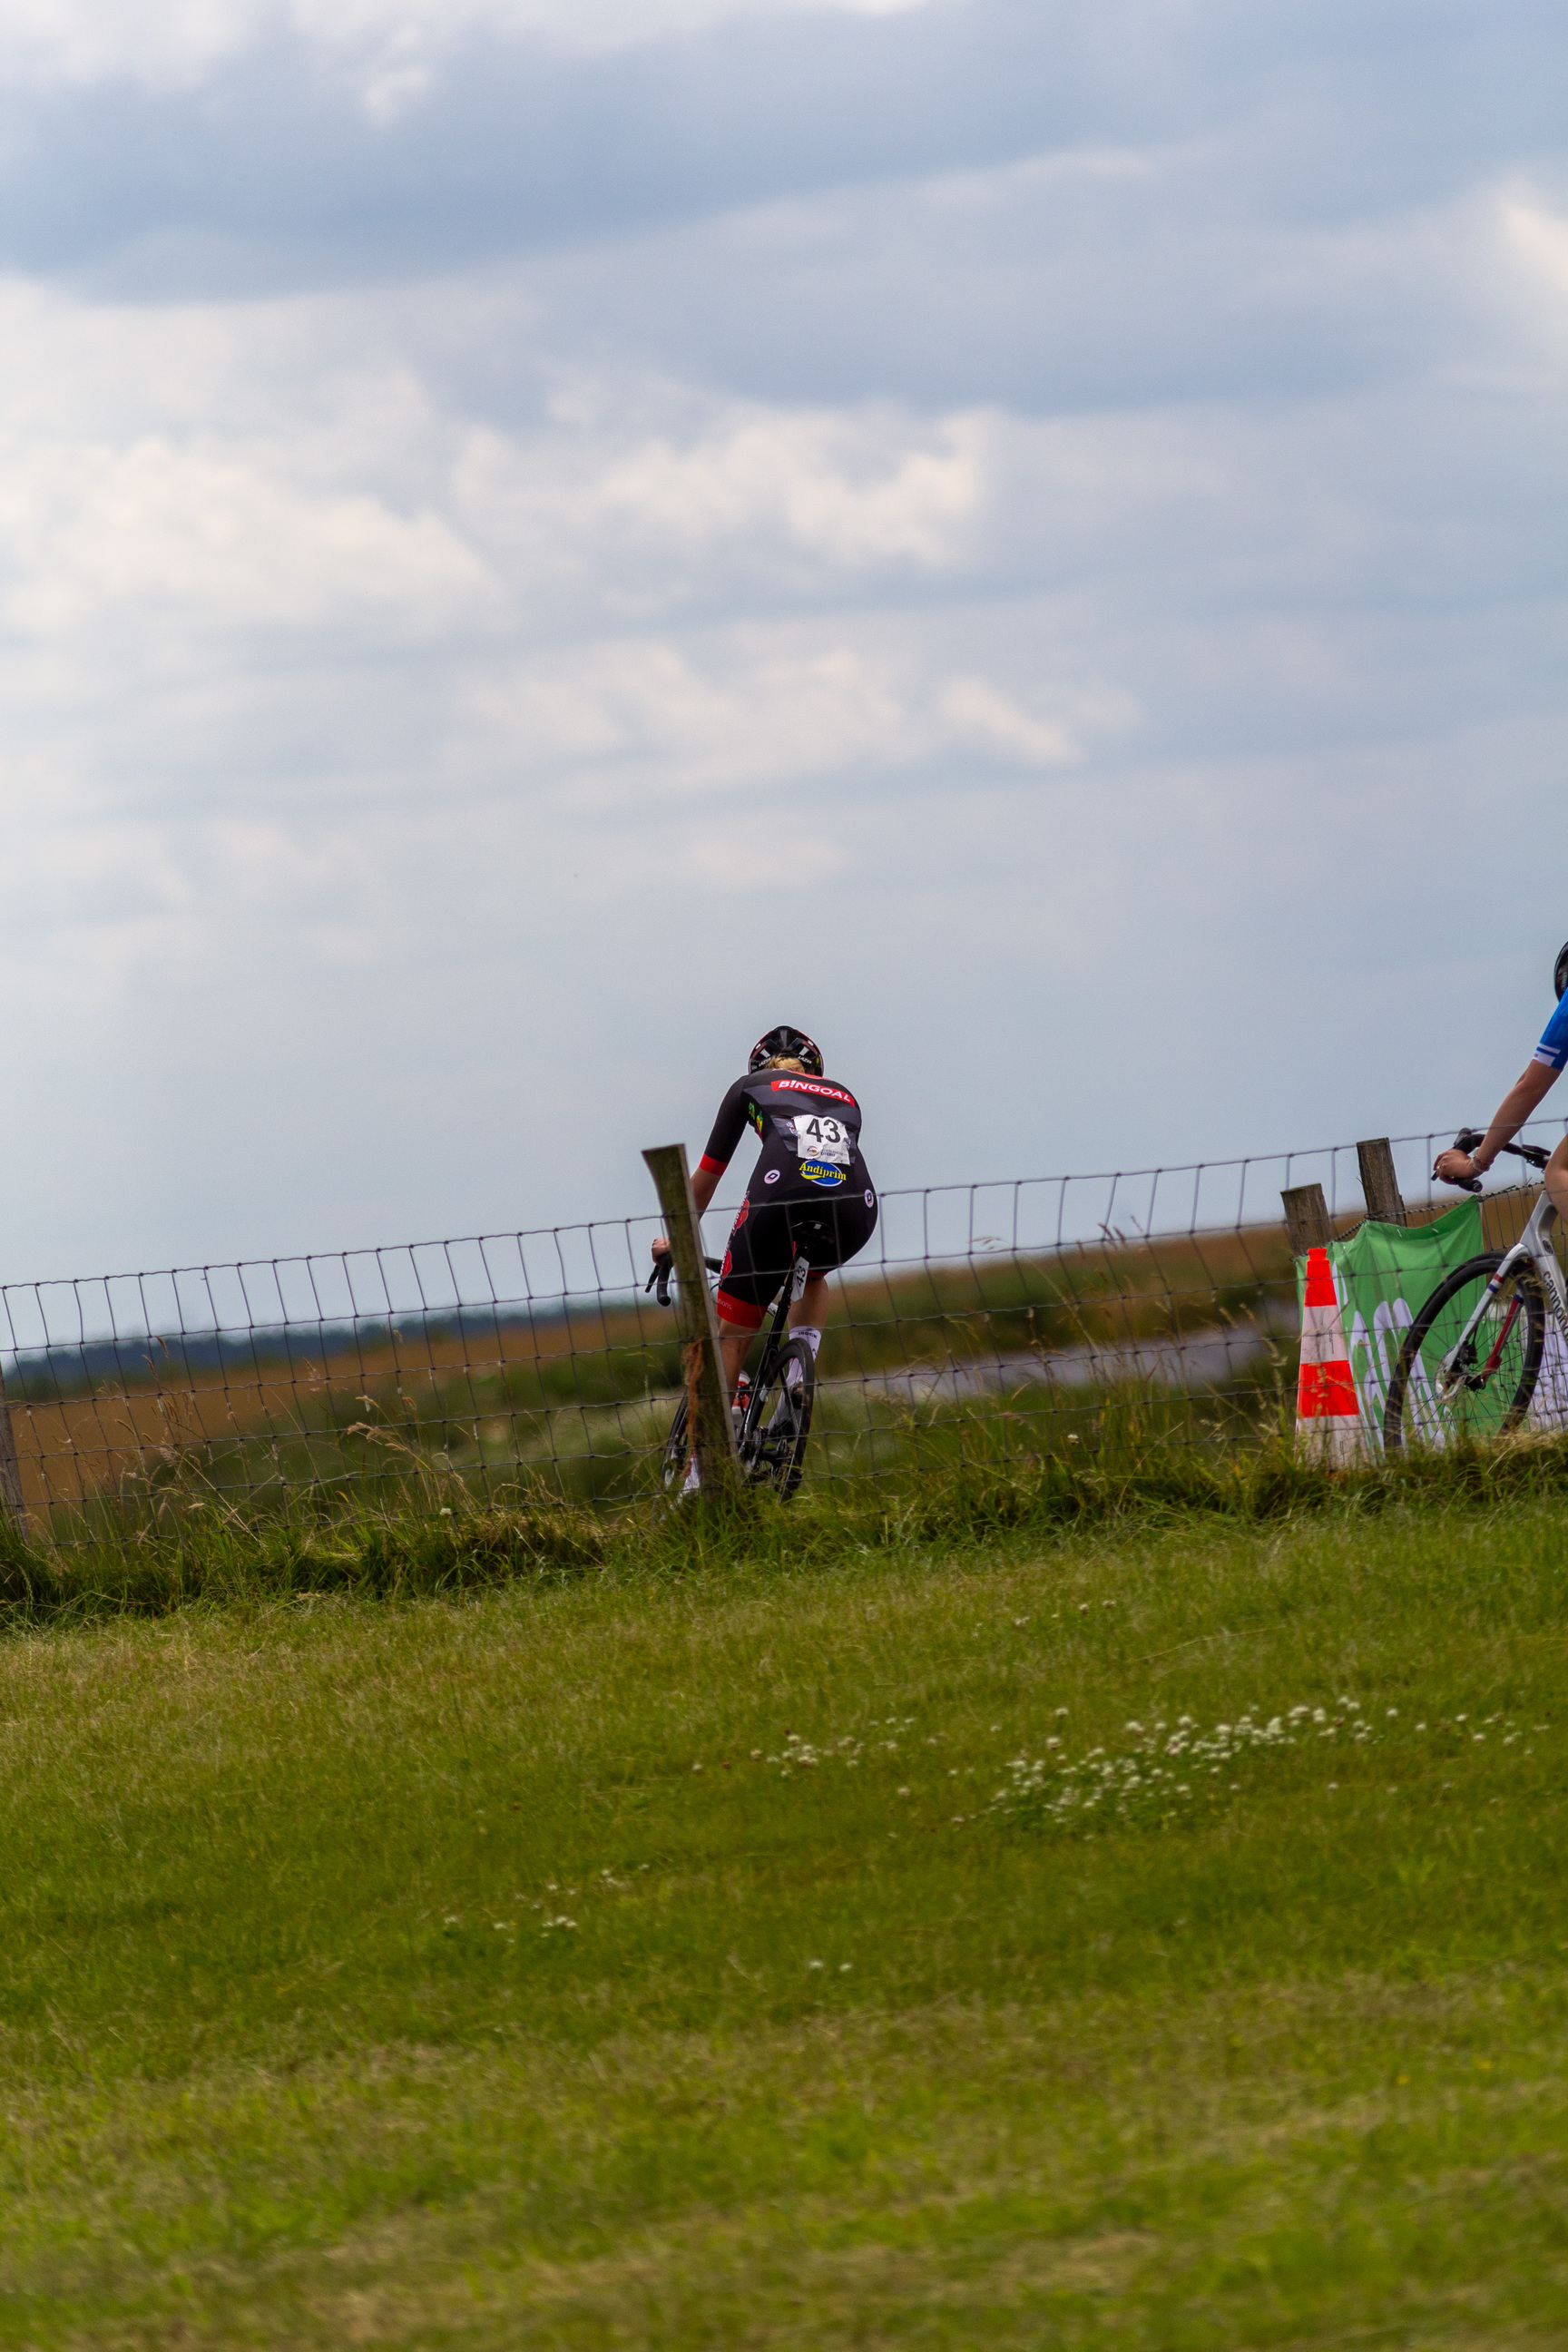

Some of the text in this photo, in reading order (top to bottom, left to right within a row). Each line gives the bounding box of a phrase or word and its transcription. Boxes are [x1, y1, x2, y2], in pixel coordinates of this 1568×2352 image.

[798, 1055, 813, 1064] LAZER
[806, 1118, 841, 1143] 43
[799, 1162, 847, 1181] Andiprim
[796, 1265, 807, 1288] 43
